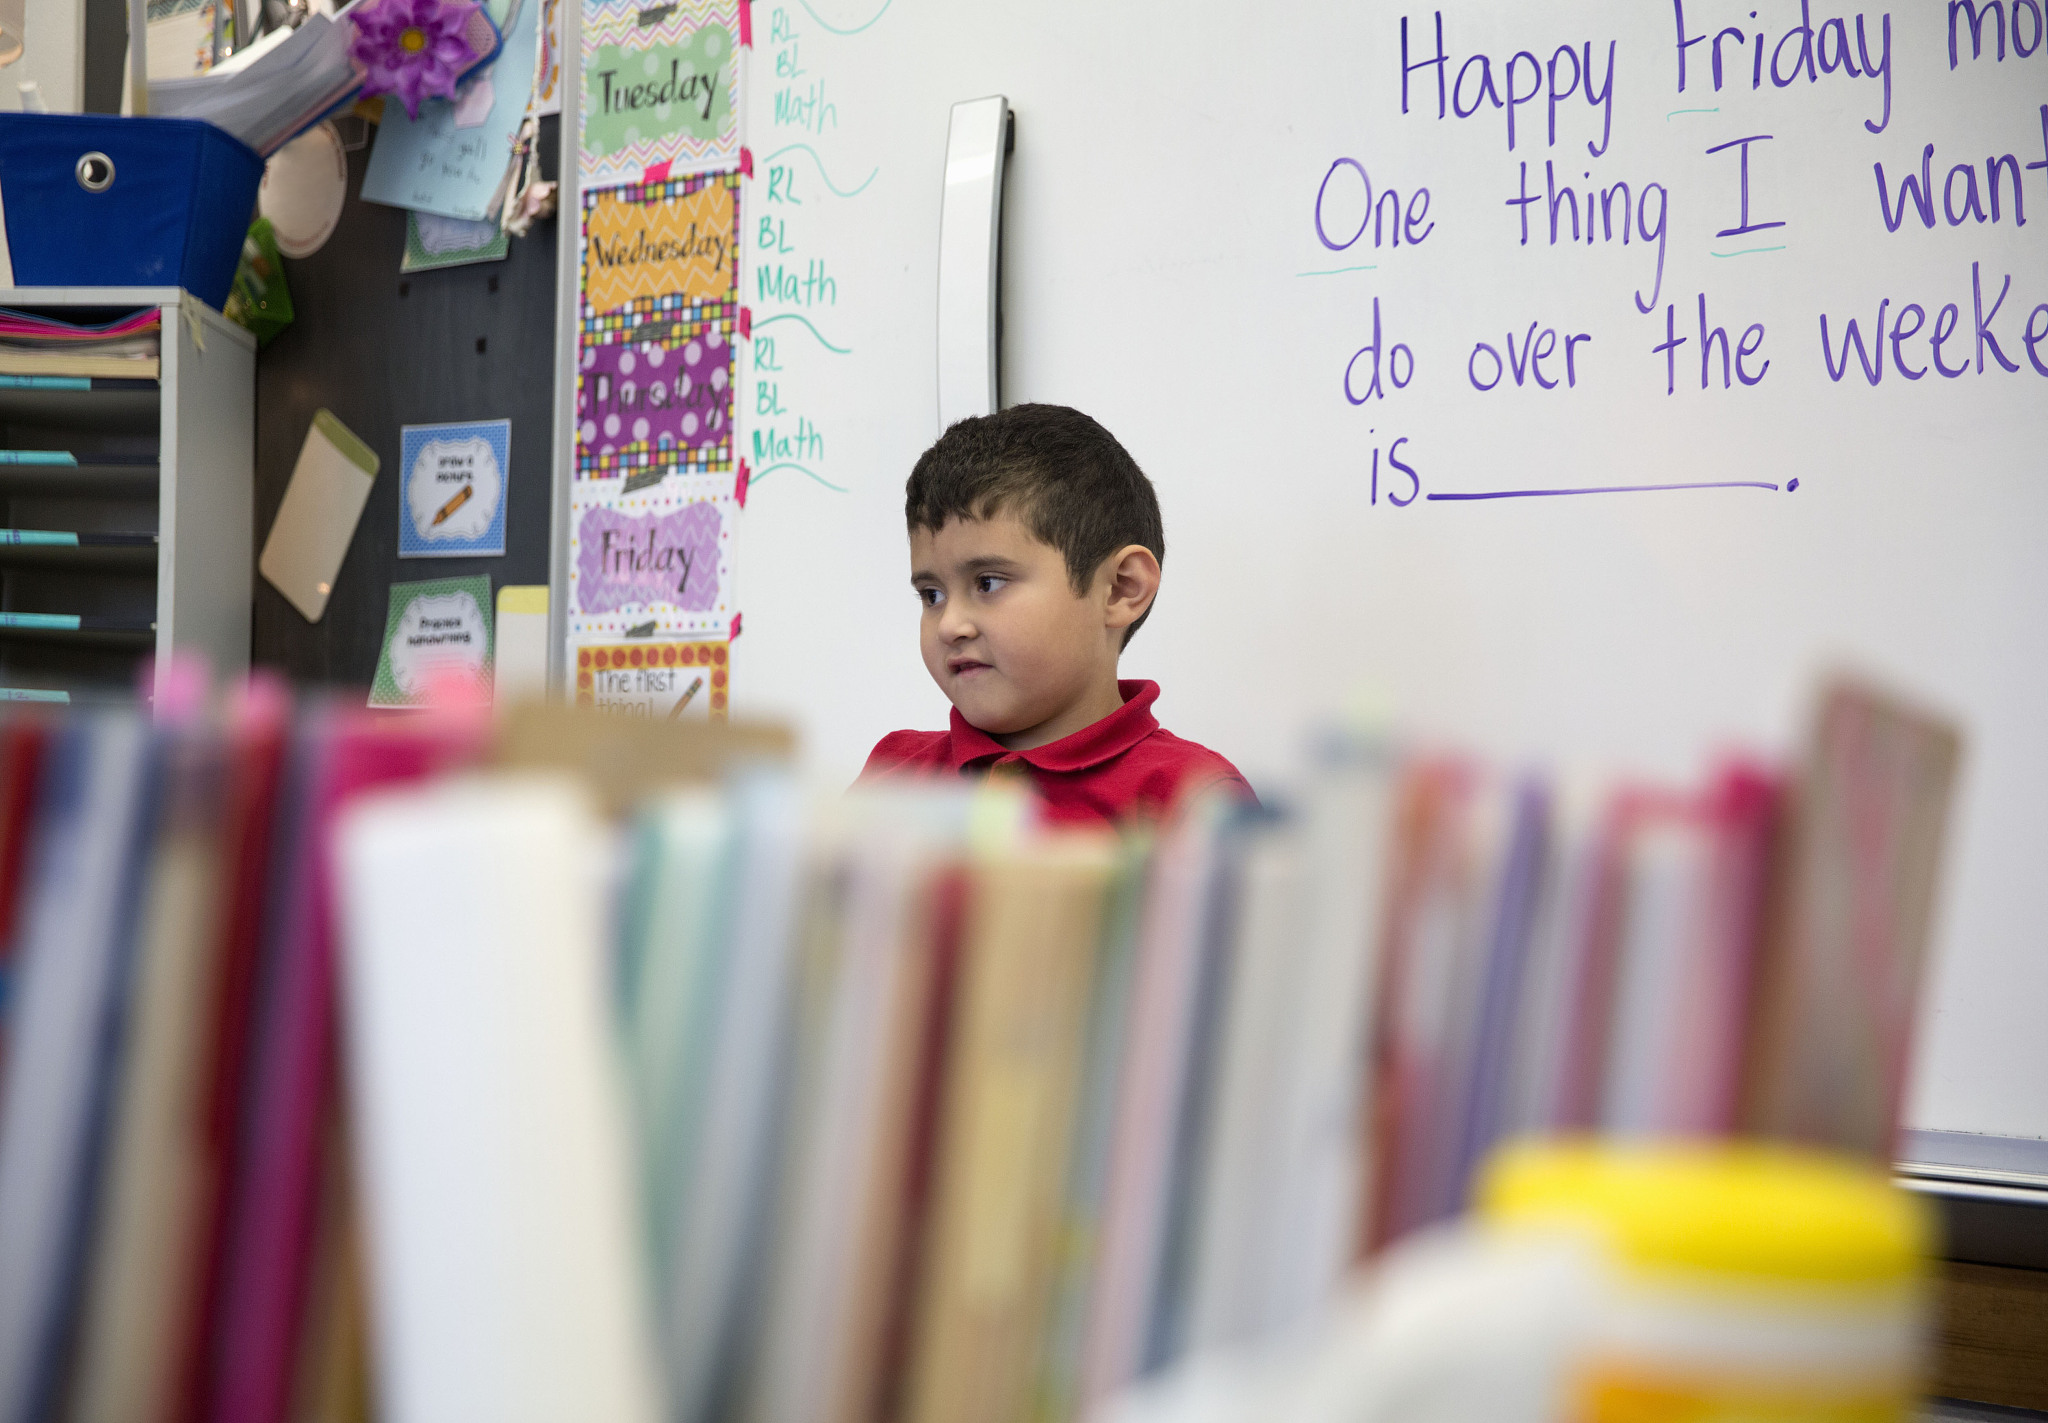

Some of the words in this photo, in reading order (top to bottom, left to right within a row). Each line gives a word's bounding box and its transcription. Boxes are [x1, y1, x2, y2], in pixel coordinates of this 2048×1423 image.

[770, 7, 800, 44] RL
[775, 42, 806, 80] BL
[1401, 11, 1616, 157] Happy
[1948, 0, 2048, 71] mo
[598, 58, 719, 121] Tuesday
[774, 79, 838, 135] Math
[767, 165, 802, 206] RL
[592, 222, 729, 273] Wednesday
[757, 215, 795, 255] BL
[1315, 157, 1436, 251] One
[1505, 160, 1668, 314] thing
[1706, 135, 1787, 238] I
[757, 258, 838, 308] Math
[753, 336, 784, 372] RL
[1344, 297, 1414, 405] do
[1468, 321, 1592, 391] over
[1652, 293, 1770, 396] the
[588, 364, 726, 430] Thursday
[756, 379, 788, 416] BL
[752, 415, 825, 467] Math
[600, 528, 697, 593] Friday
[596, 668, 631, 693] The
